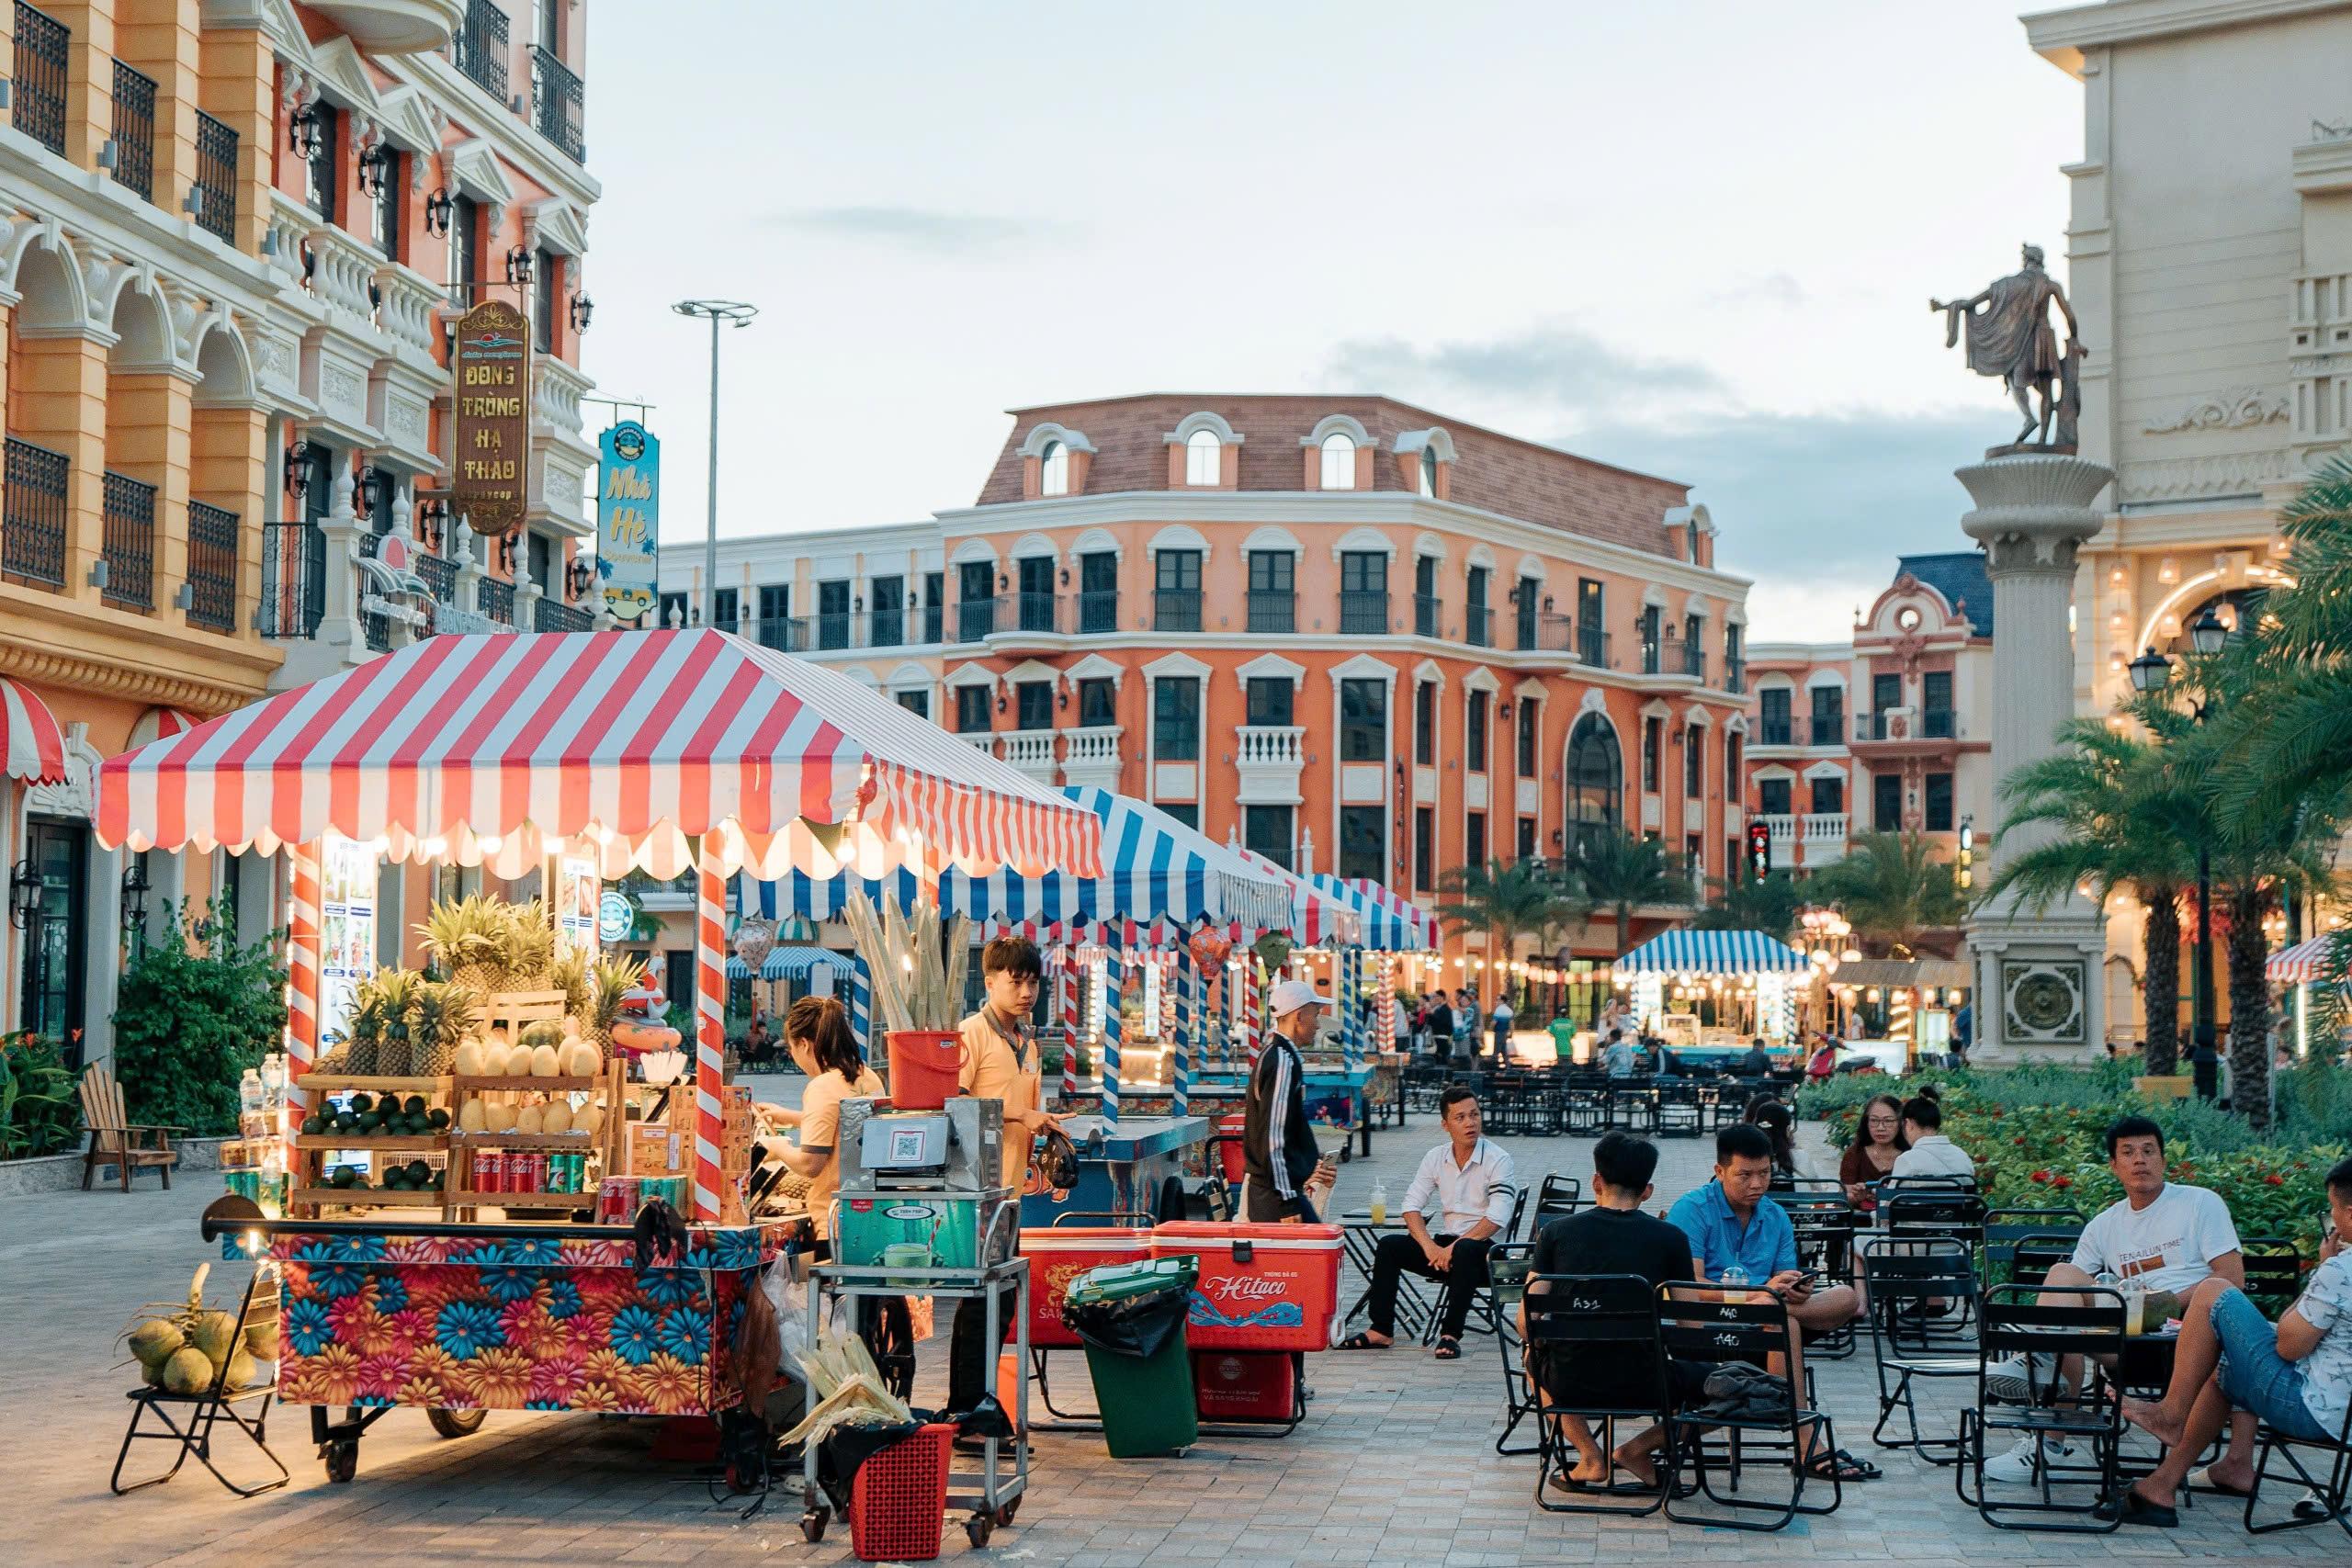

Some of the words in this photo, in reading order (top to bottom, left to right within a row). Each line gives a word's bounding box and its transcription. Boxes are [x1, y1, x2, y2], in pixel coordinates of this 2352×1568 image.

[462, 390, 520, 418] TRÙNG
[474, 428, 502, 453] HẠ
[1204, 1276, 1286, 1301] Hitaco
[1573, 1297, 1601, 1310] A31
